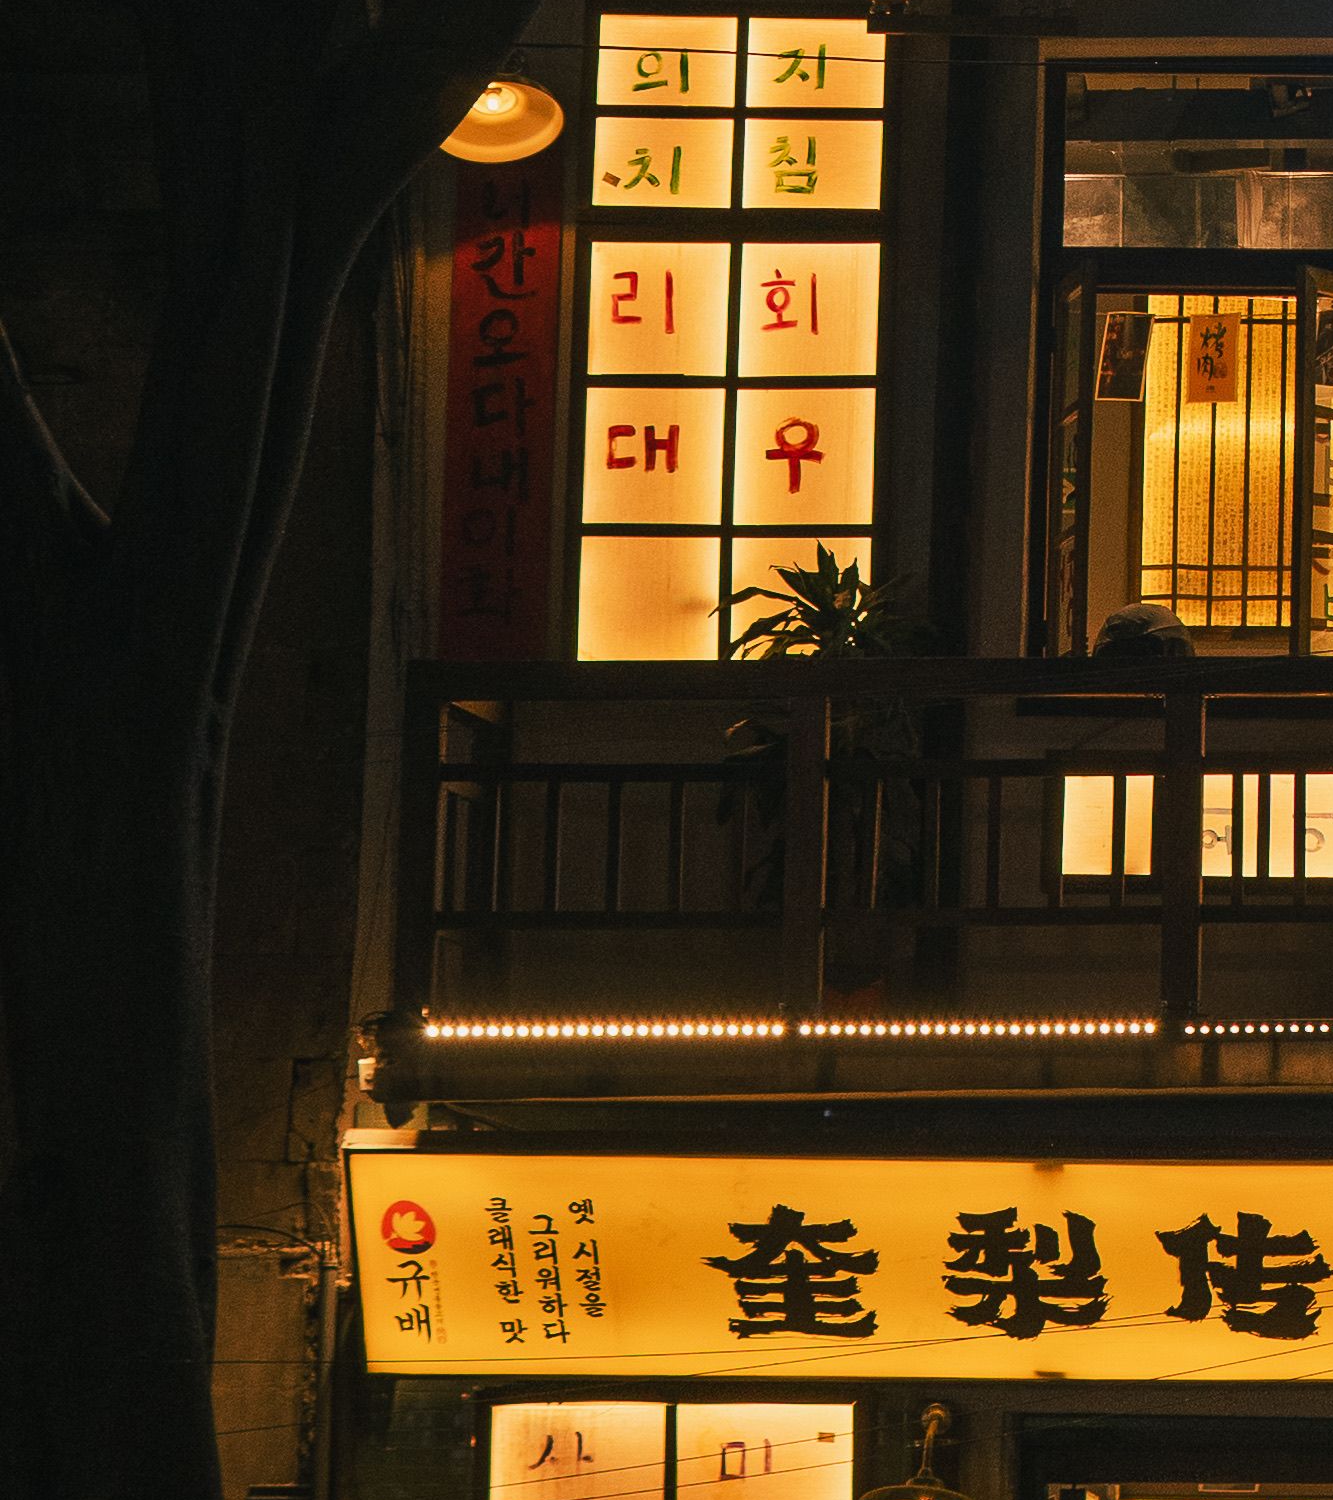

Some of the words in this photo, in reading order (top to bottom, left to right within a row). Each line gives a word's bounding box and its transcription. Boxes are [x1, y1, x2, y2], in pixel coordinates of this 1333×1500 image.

[622, 145, 684, 196] 치
[768, 135, 819, 195] 침
[610, 271, 675, 335] 리
[759, 269, 821, 335] 회
[604, 423, 681, 474] 대
[764, 416, 823, 494] 우
[484, 1196, 525, 1304] 클래식한
[527, 1213, 572, 1345] 그리워하다
[572, 1238, 608, 1318] 시절을
[385, 1259, 432, 1345] 규배
[499, 1317, 529, 1345] 맛
